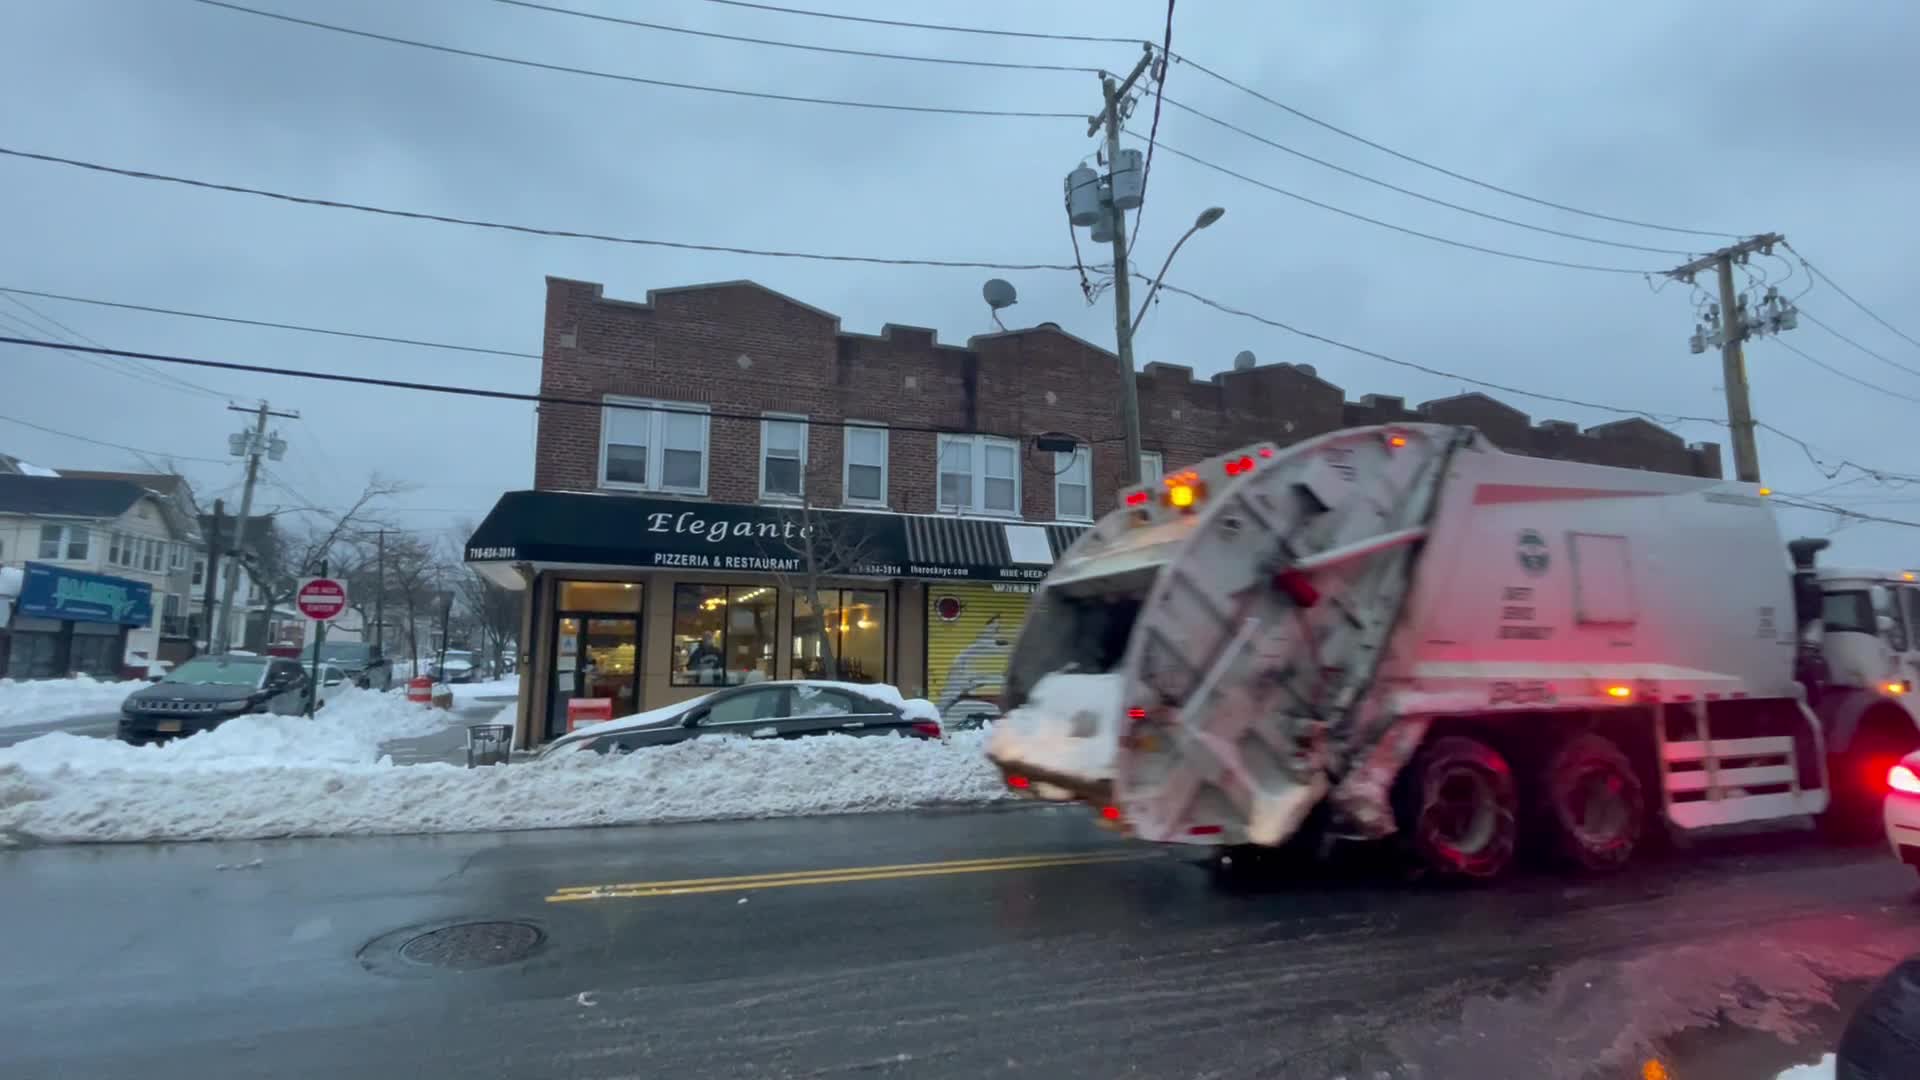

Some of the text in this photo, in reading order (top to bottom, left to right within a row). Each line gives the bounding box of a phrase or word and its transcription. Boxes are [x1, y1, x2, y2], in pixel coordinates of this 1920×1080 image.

[655, 553, 800, 571] PIZZERIA & RESTAURANT
[910, 565, 969, 577] therocknyc.com
